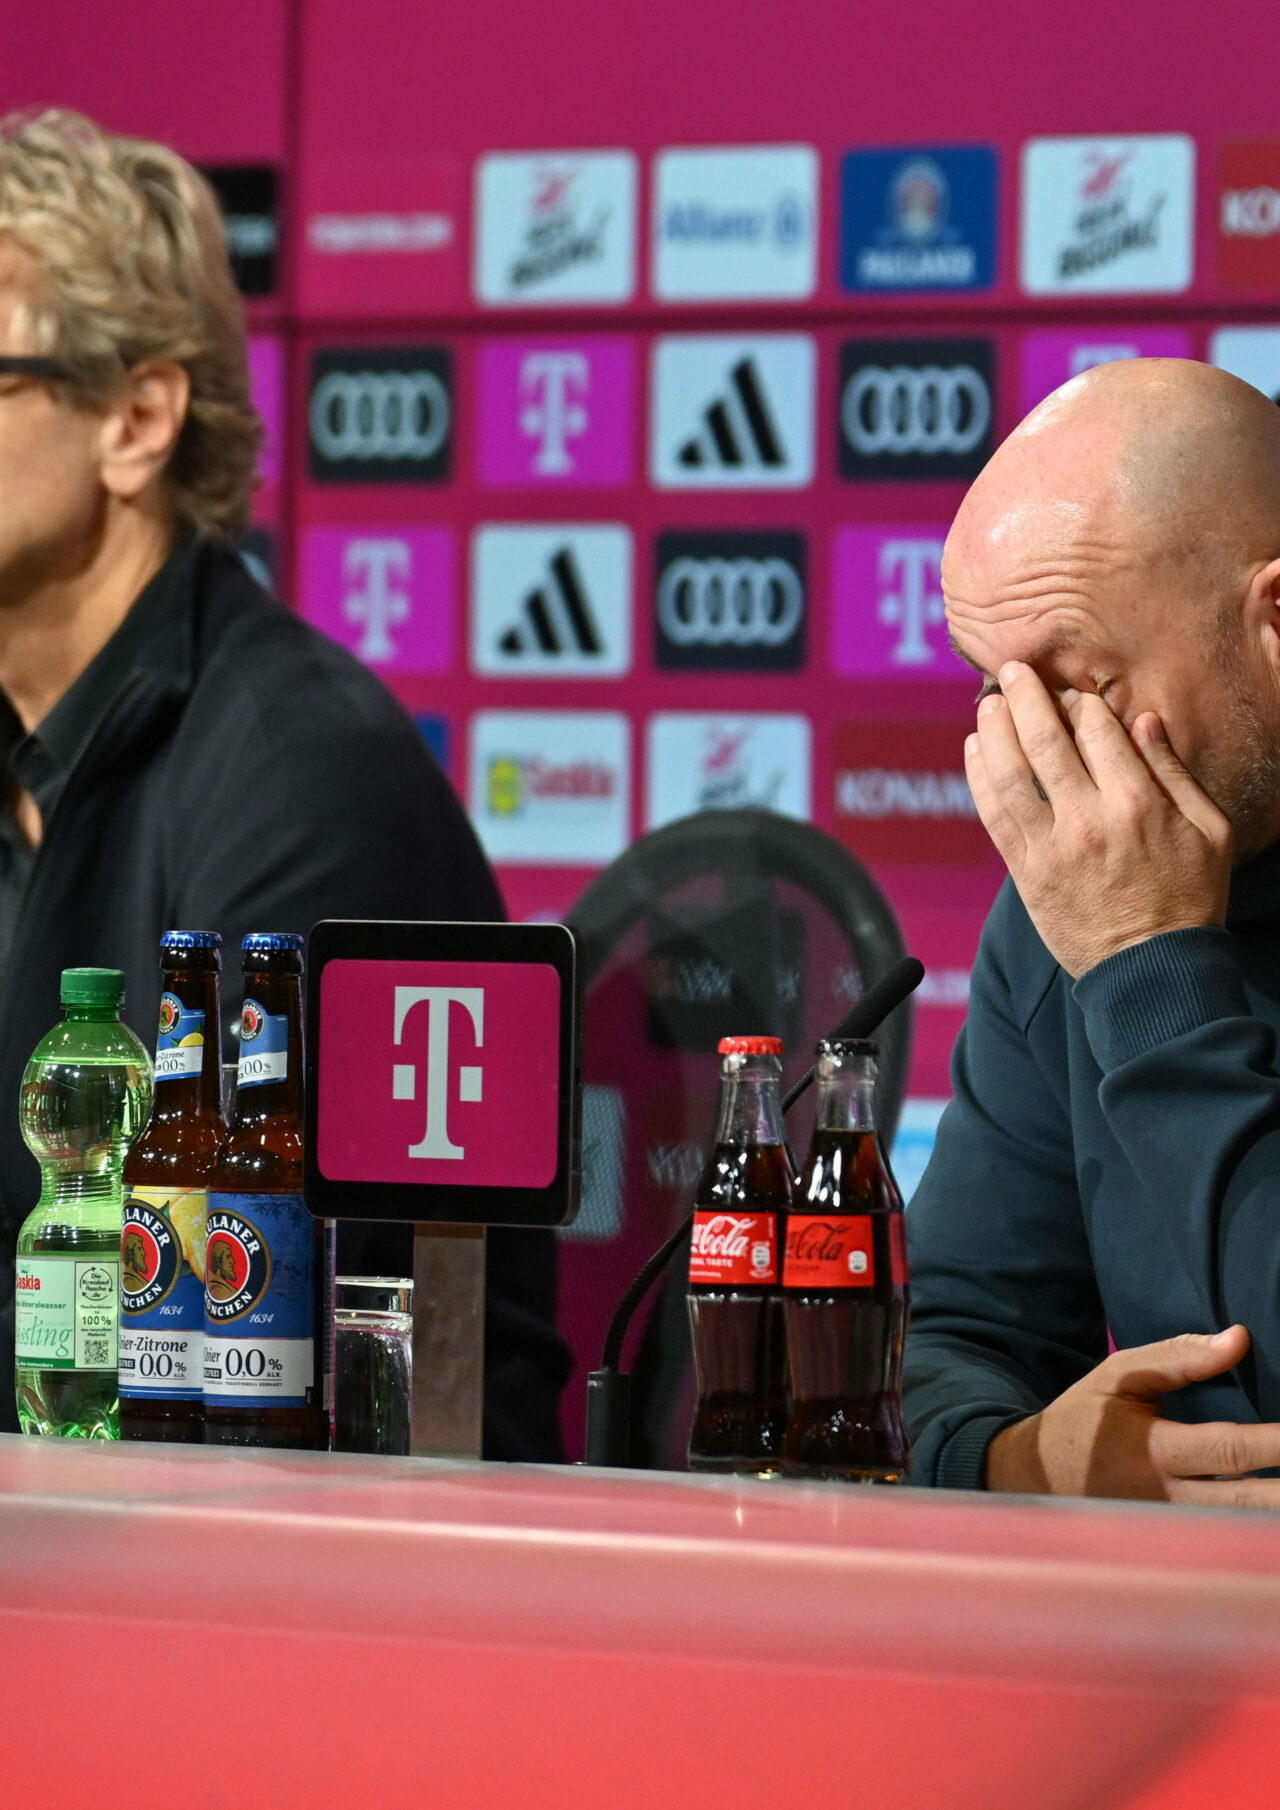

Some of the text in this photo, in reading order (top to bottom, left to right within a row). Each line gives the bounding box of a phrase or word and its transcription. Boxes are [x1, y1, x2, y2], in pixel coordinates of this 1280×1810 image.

[837, 770, 975, 817] KONAM
[206, 1215, 260, 1255] ULANER
[159, 1305, 183, 1315] 1634
[249, 1313, 274, 1324] 1634
